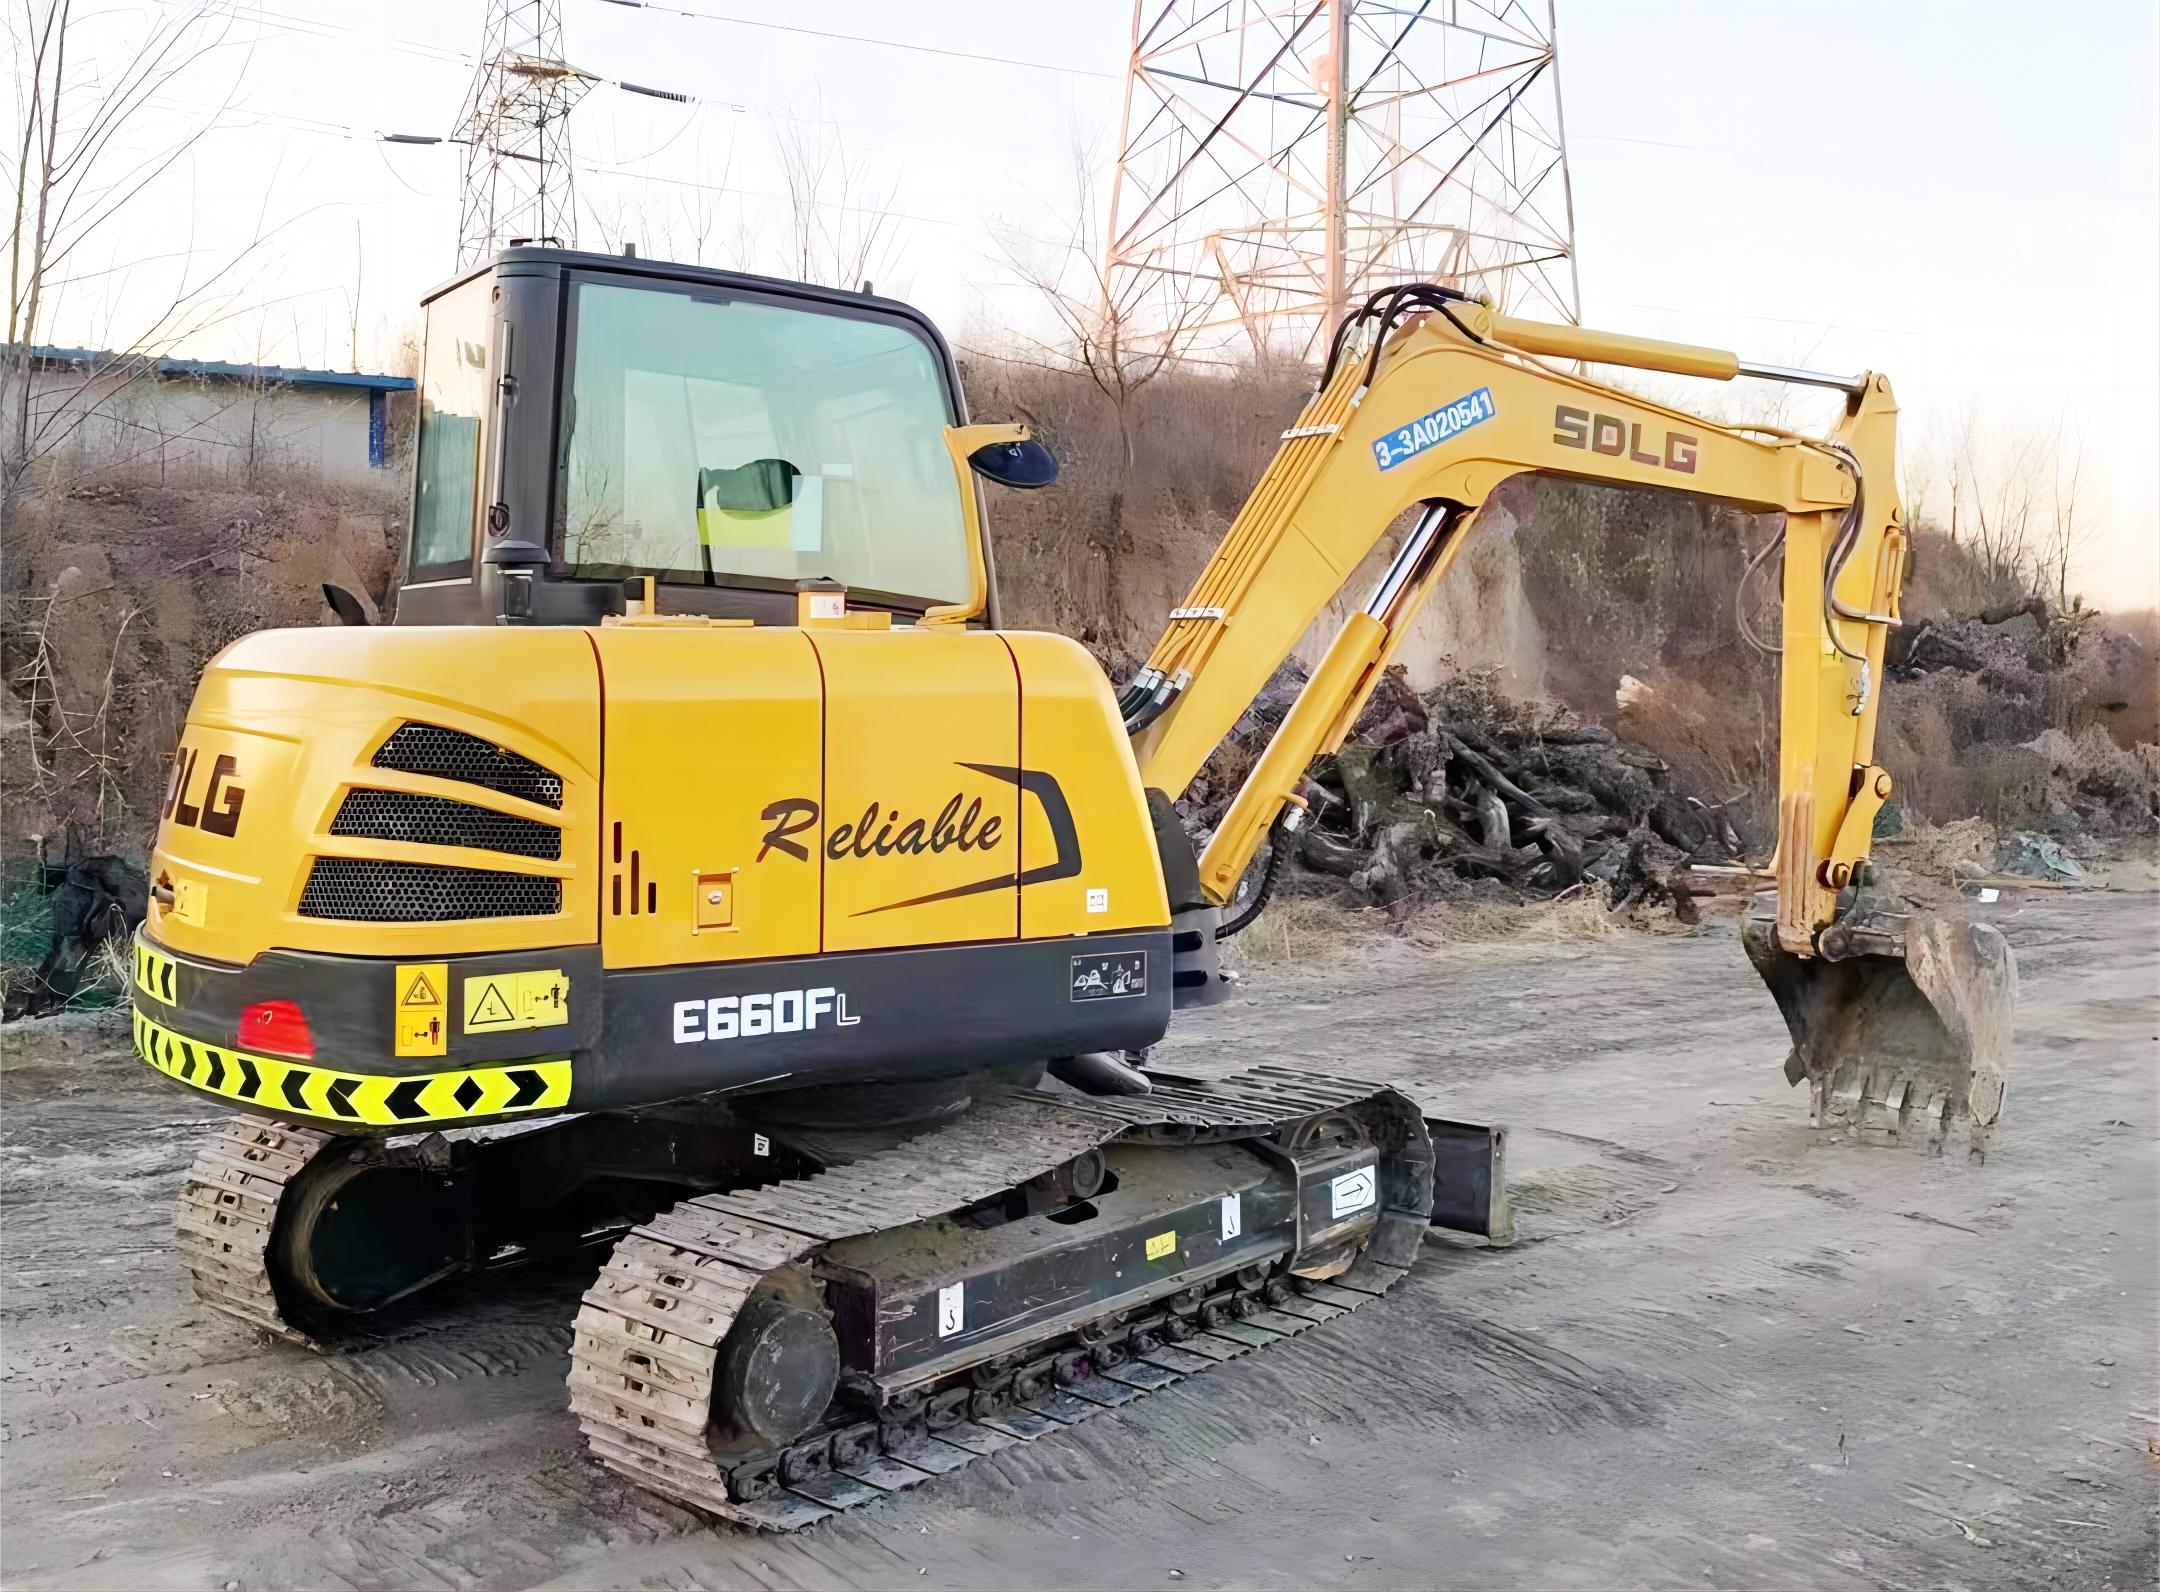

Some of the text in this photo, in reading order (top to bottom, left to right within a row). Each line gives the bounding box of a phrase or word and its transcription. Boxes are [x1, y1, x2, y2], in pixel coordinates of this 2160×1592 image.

[1376, 391, 1493, 467] 3-3A020541
[1553, 404, 1698, 474] SDLG
[755, 792, 1002, 862] Reliable
